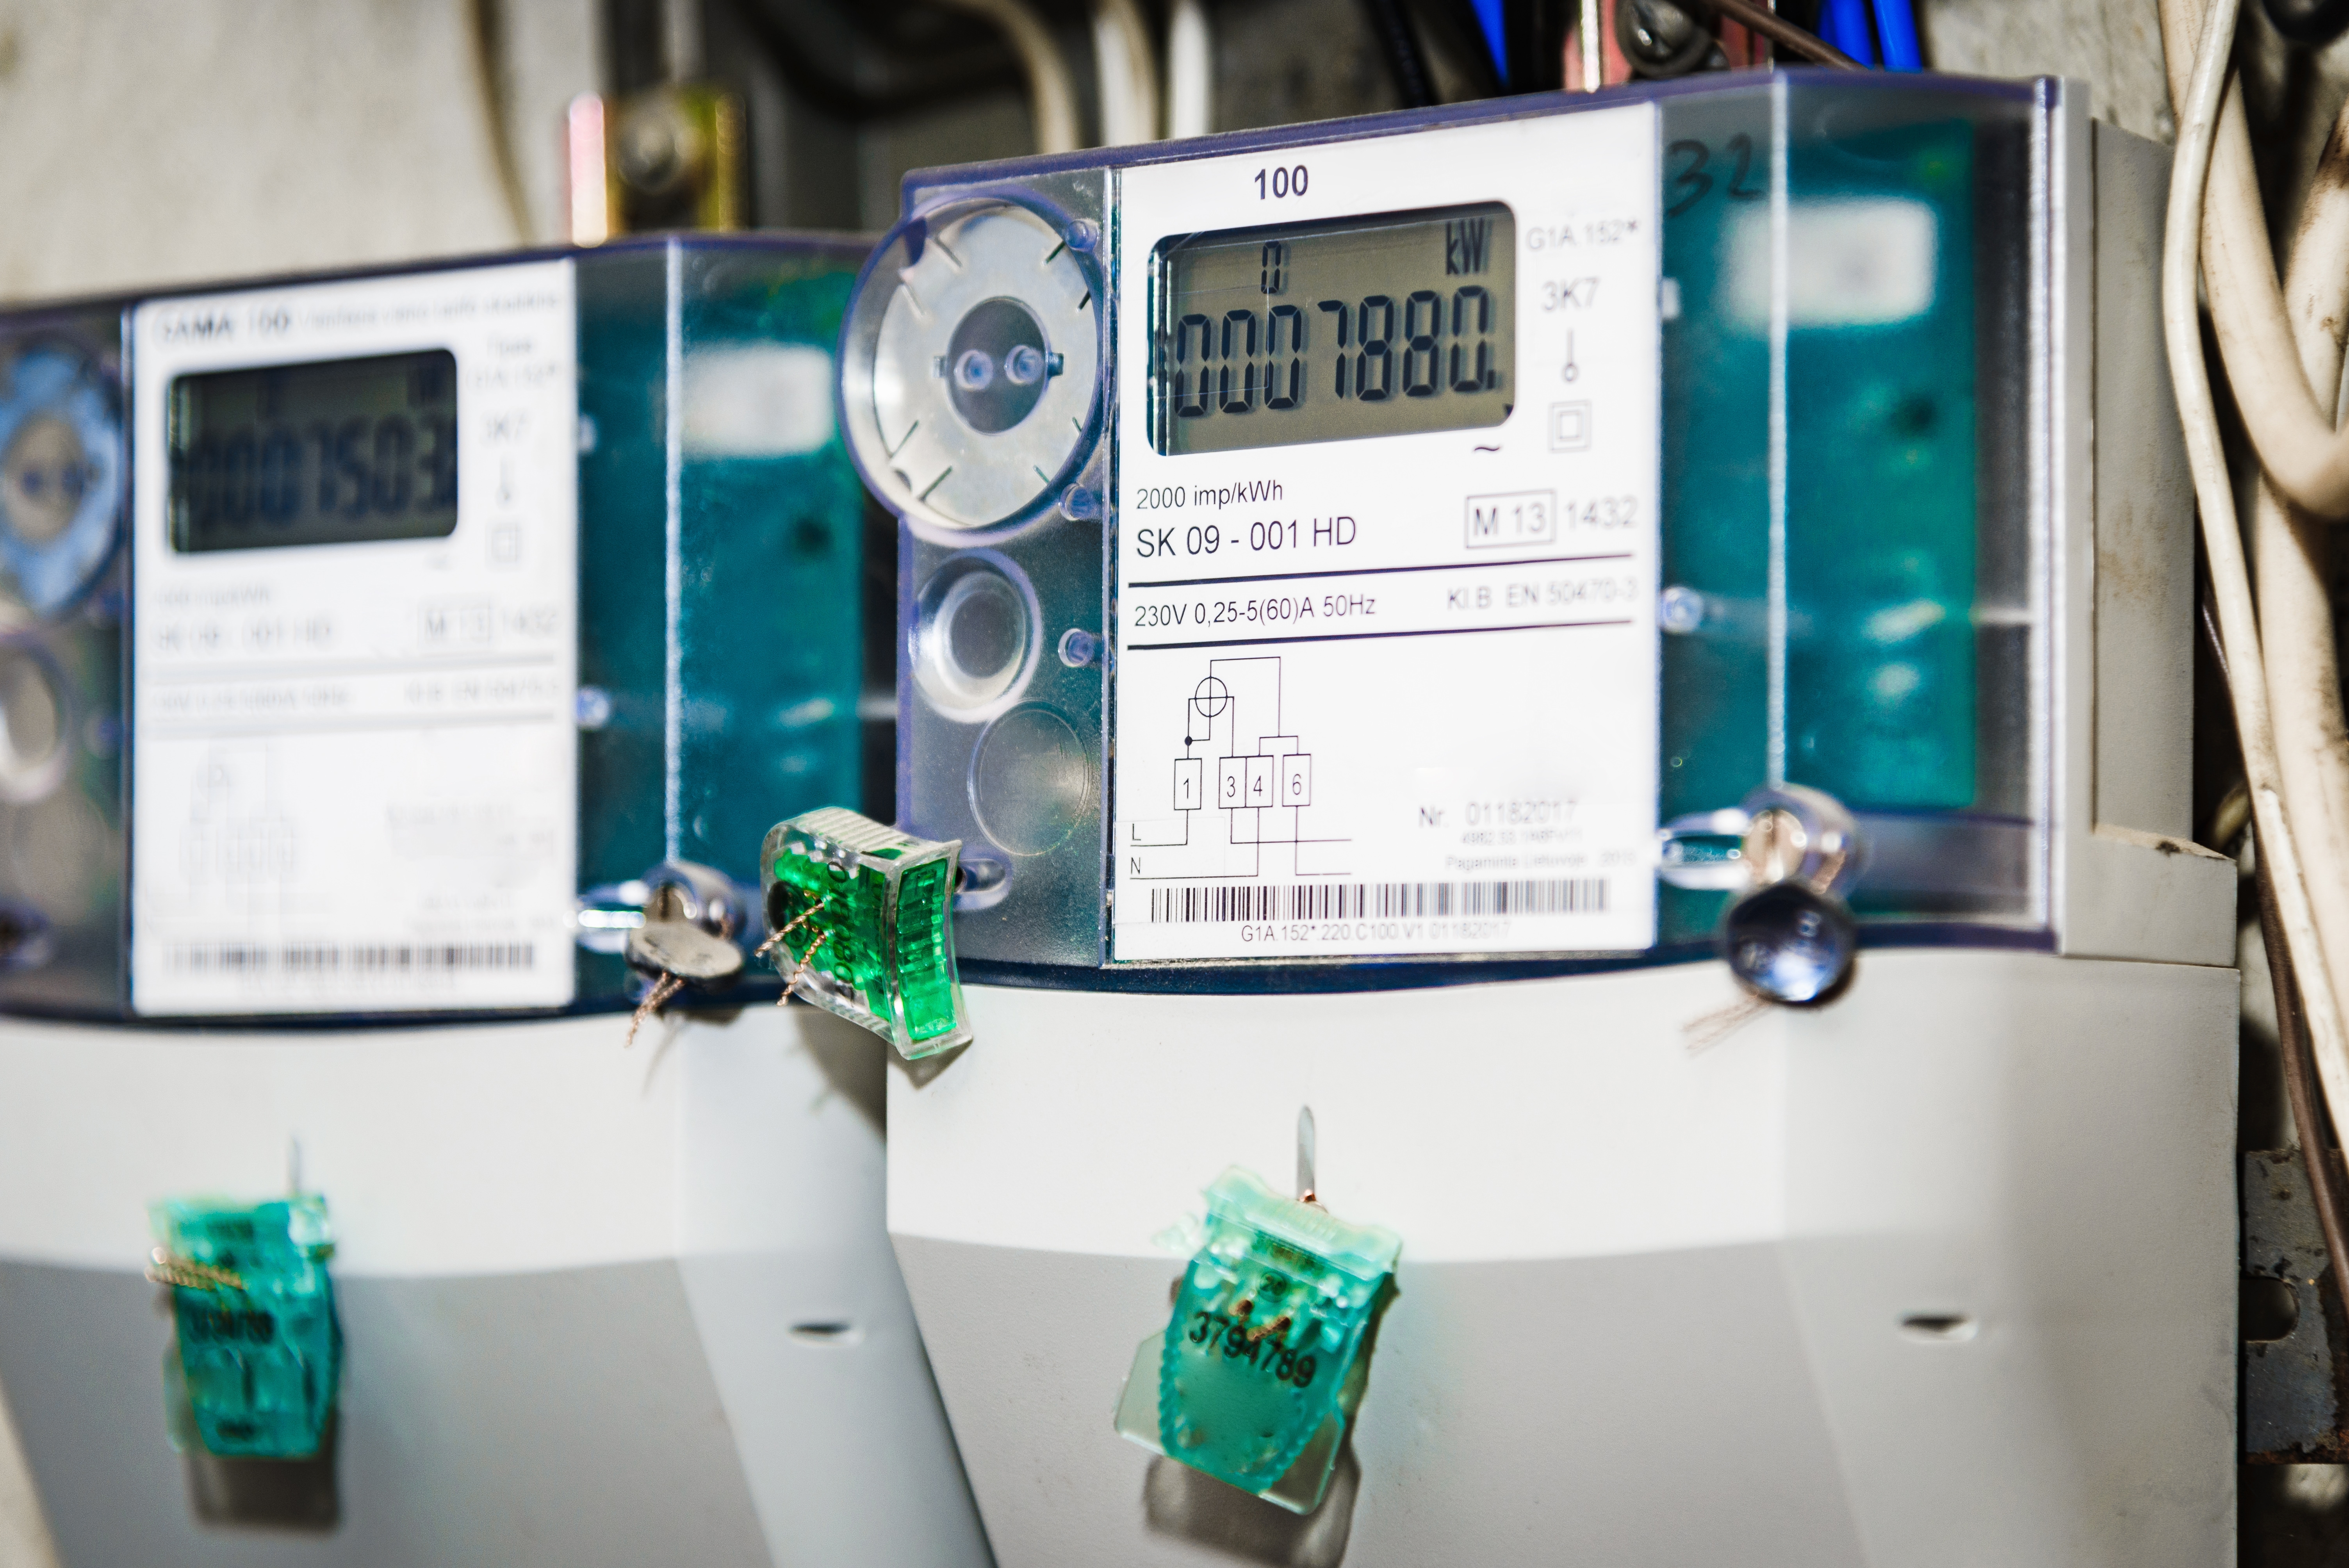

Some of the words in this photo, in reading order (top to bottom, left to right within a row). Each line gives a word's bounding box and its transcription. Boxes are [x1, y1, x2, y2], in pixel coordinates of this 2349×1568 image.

[1254, 165, 1308, 200] 100
[1445, 217, 1487, 276] kW
[1542, 278, 1600, 312] 3K7
[1136, 486, 1186, 509] 2000
[1194, 479, 1283, 510] imp/kWh
[1473, 507, 1499, 537] M
[1514, 502, 1546, 534] 13
[1567, 495, 1638, 529] 1432
[1136, 527, 1176, 557] SK
[1187, 525, 1220, 555] 09
[1250, 519, 1297, 551] 001
[1313, 516, 1356, 547] HD
[1506, 583, 1539, 608] EN
[1134, 603, 1187, 627] 230V
[1194, 597, 1315, 627] 0,25-5(60)A
[1323, 594, 1376, 617] 50Hz
[1183, 778, 1189, 799] 1
[1227, 776, 1236, 797] 3
[1253, 775, 1263, 797] 4
[1292, 773, 1302, 795] 6
[1132, 823, 1141, 841] L
[1131, 857, 1141, 875] N
